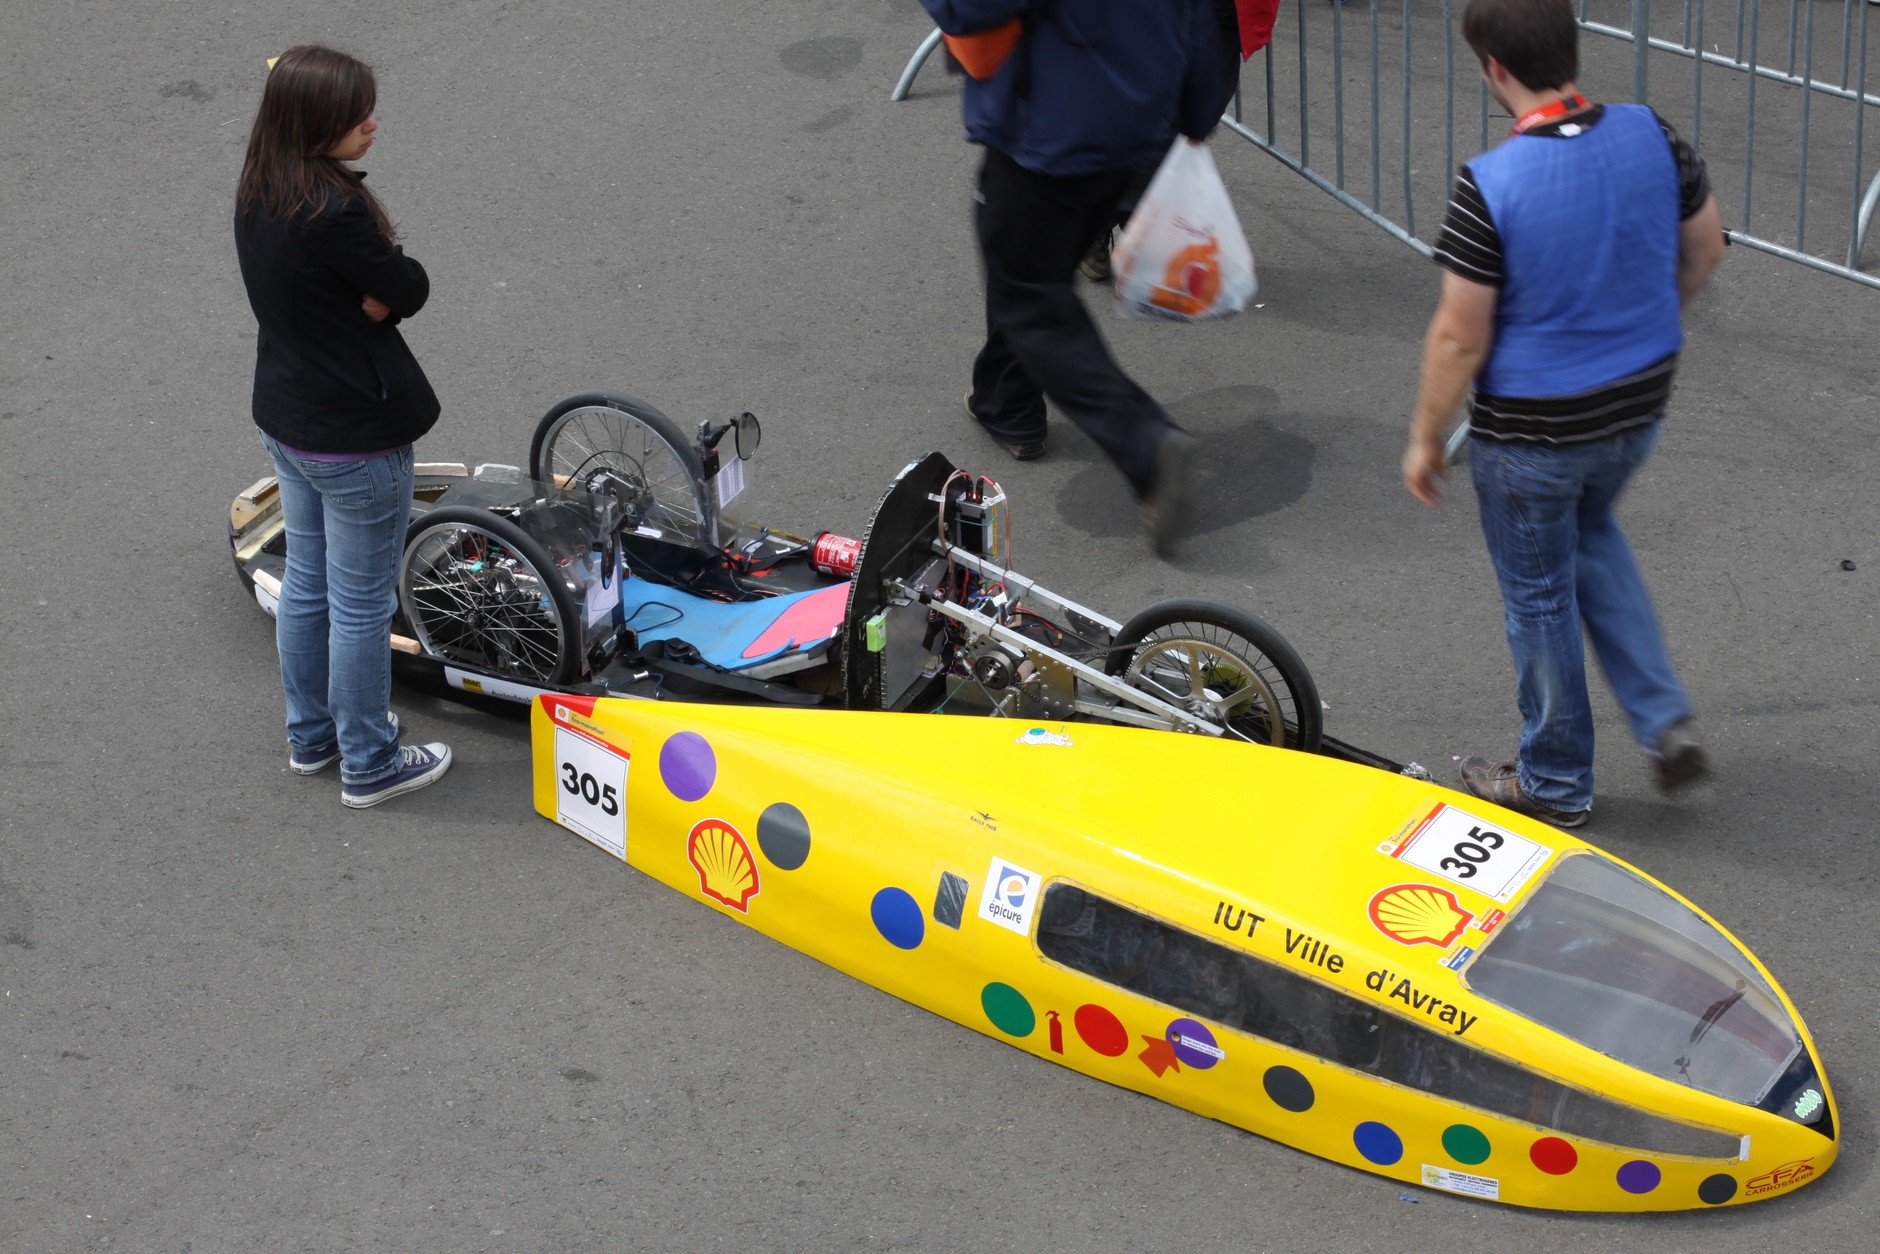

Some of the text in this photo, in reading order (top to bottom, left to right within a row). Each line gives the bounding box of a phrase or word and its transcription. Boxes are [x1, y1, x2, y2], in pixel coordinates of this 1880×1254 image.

[561, 762, 619, 817] 305
[1439, 826, 1505, 879] 305
[988, 900, 1022, 924] épicure
[1213, 901, 1478, 1036] IUT Ville d'Avray
[1745, 1171, 1815, 1197] CARROSSERIE
[1746, 1164, 1815, 1190] CFA
